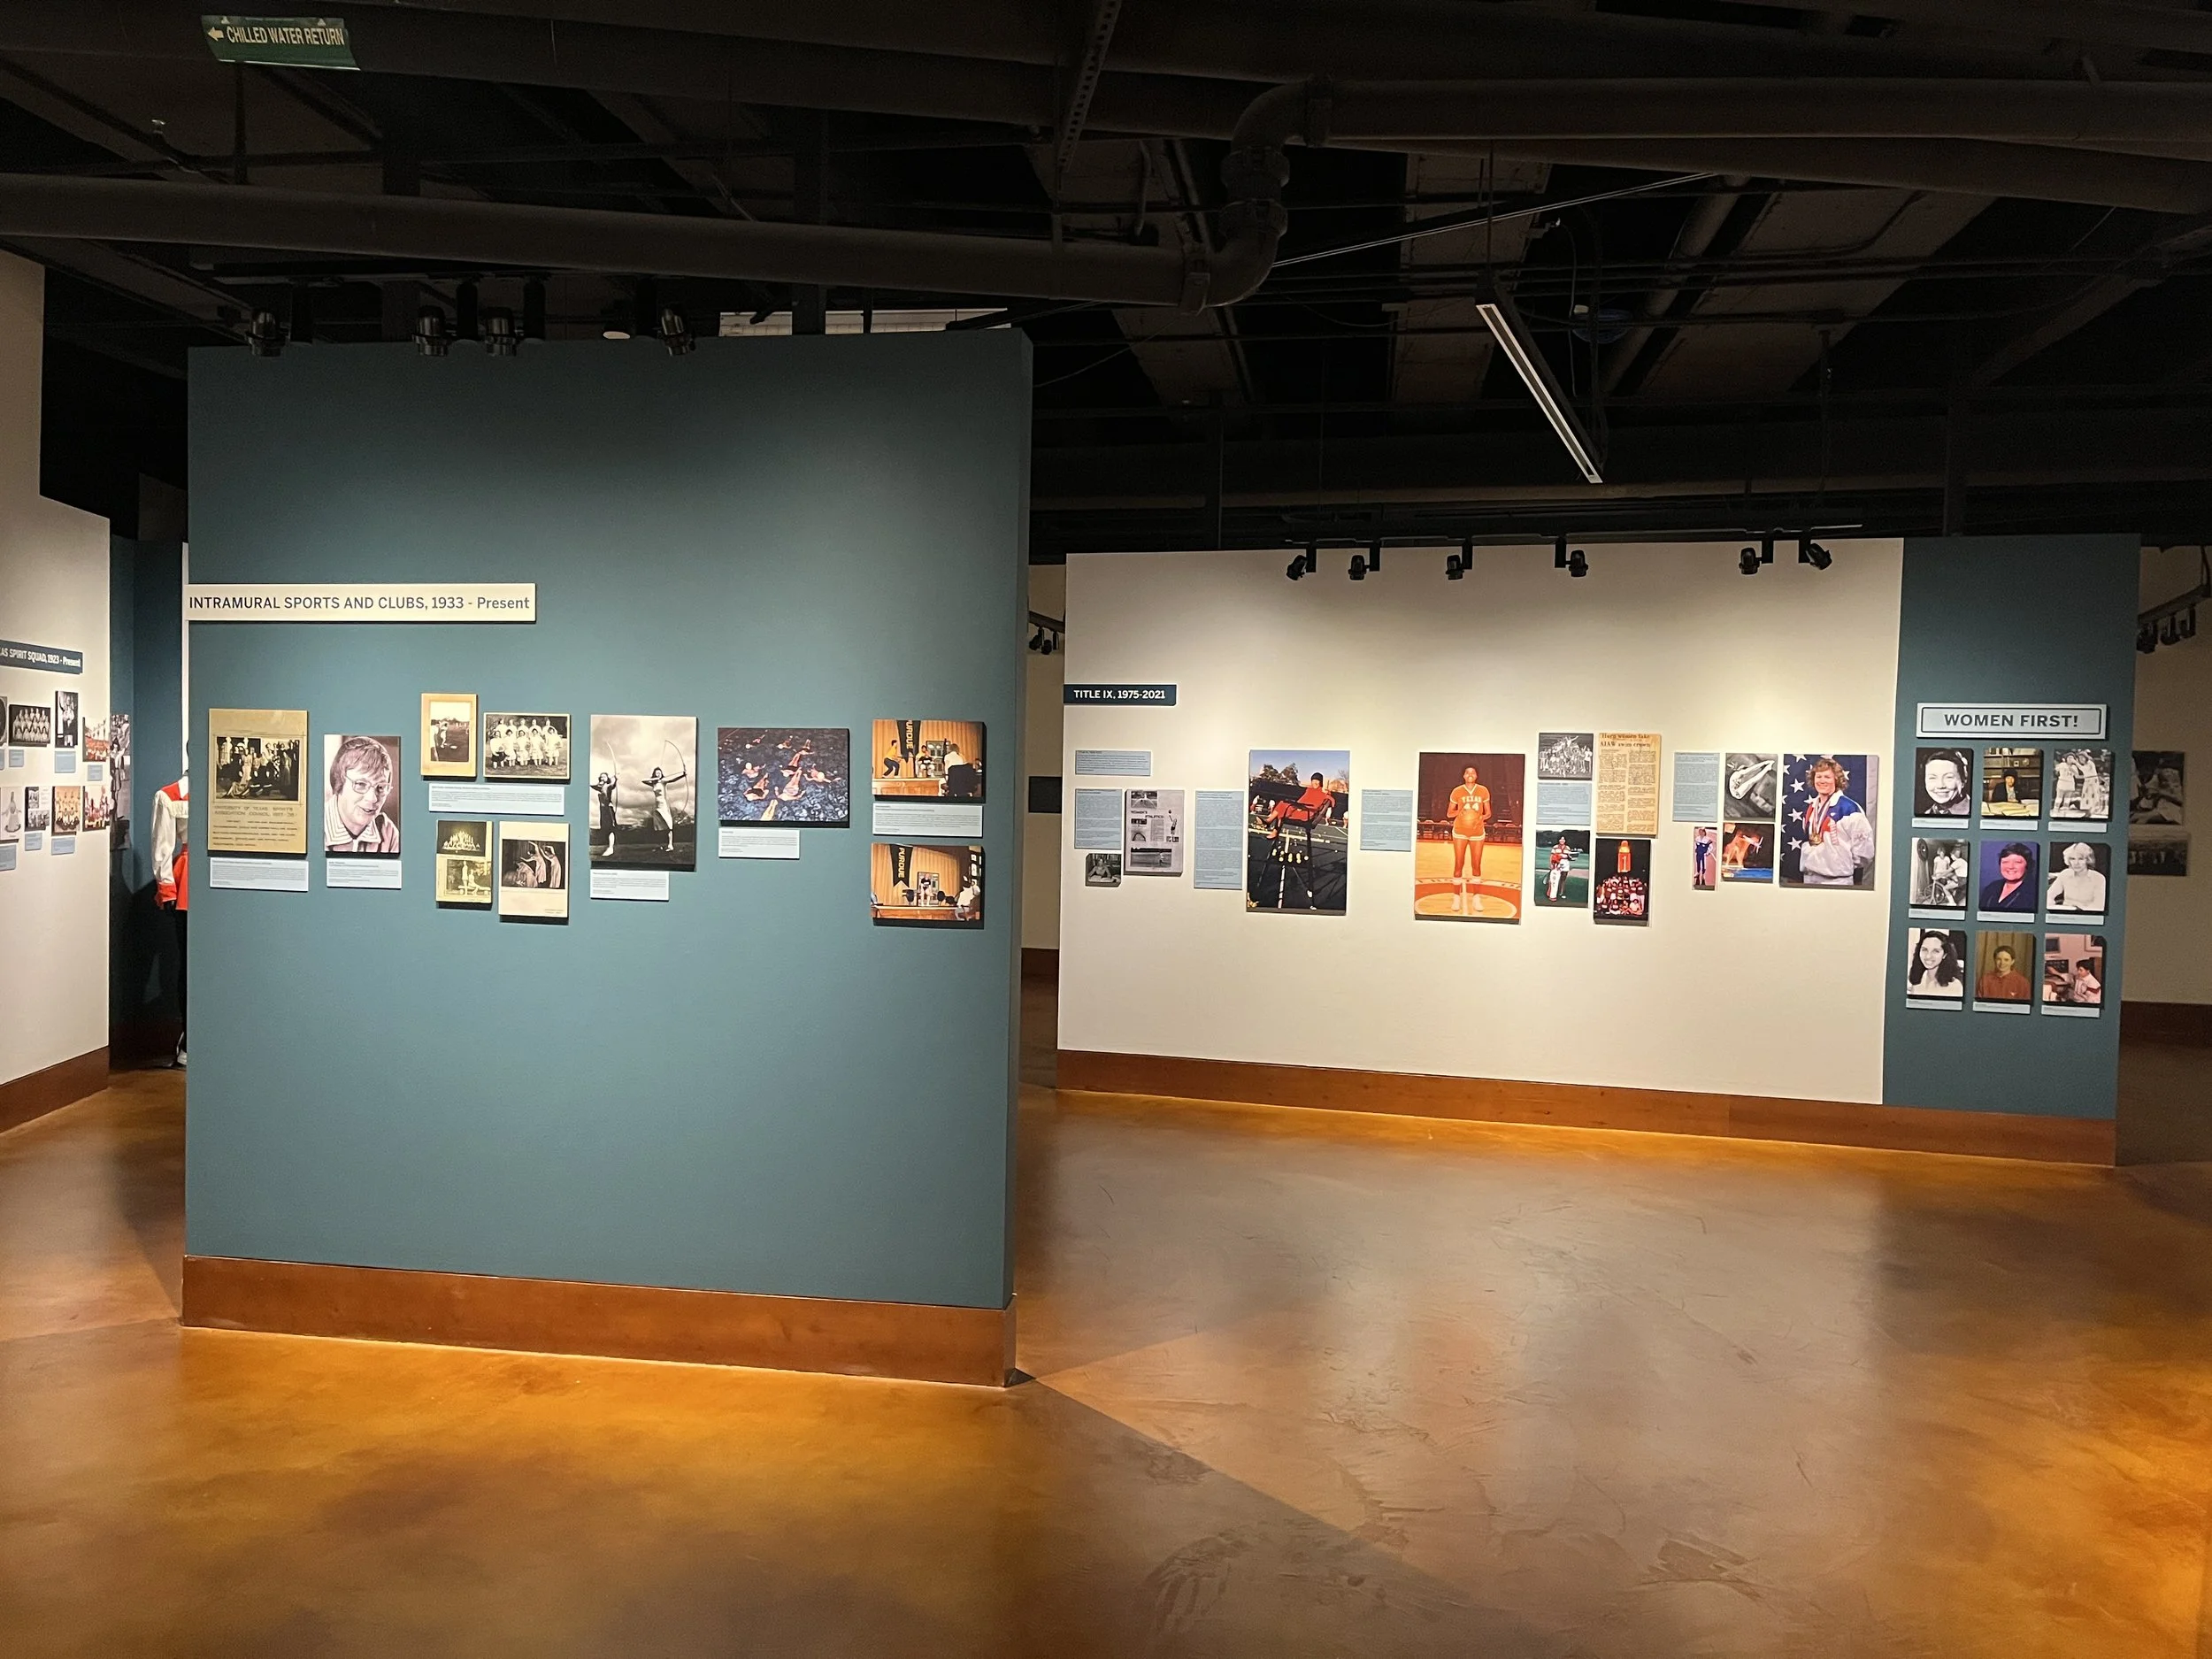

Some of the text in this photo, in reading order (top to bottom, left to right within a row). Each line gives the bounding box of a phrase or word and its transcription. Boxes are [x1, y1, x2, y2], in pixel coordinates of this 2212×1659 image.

[227, 26, 345, 45] CHILLED WATER RETURN
[189, 596, 280, 609] INTRAMURAL
[284, 596, 340, 609] SPORTS
[343, 596, 373, 609] AND
[378, 596, 428, 611] CLUBS,
[432, 596, 464, 609] 1933
[477, 596, 530, 609] Present
[9, 648, 27, 660] SPIRIT
[27, 650, 48, 664] SQUAD,
[47, 653, 60, 664] 1923
[62, 656, 81, 667] Present
[1073, 690, 1101, 699] TITLE
[1118, 689, 1165, 699] 1975-2021
[1944, 714, 2078, 727] WOMEN FIRST!
